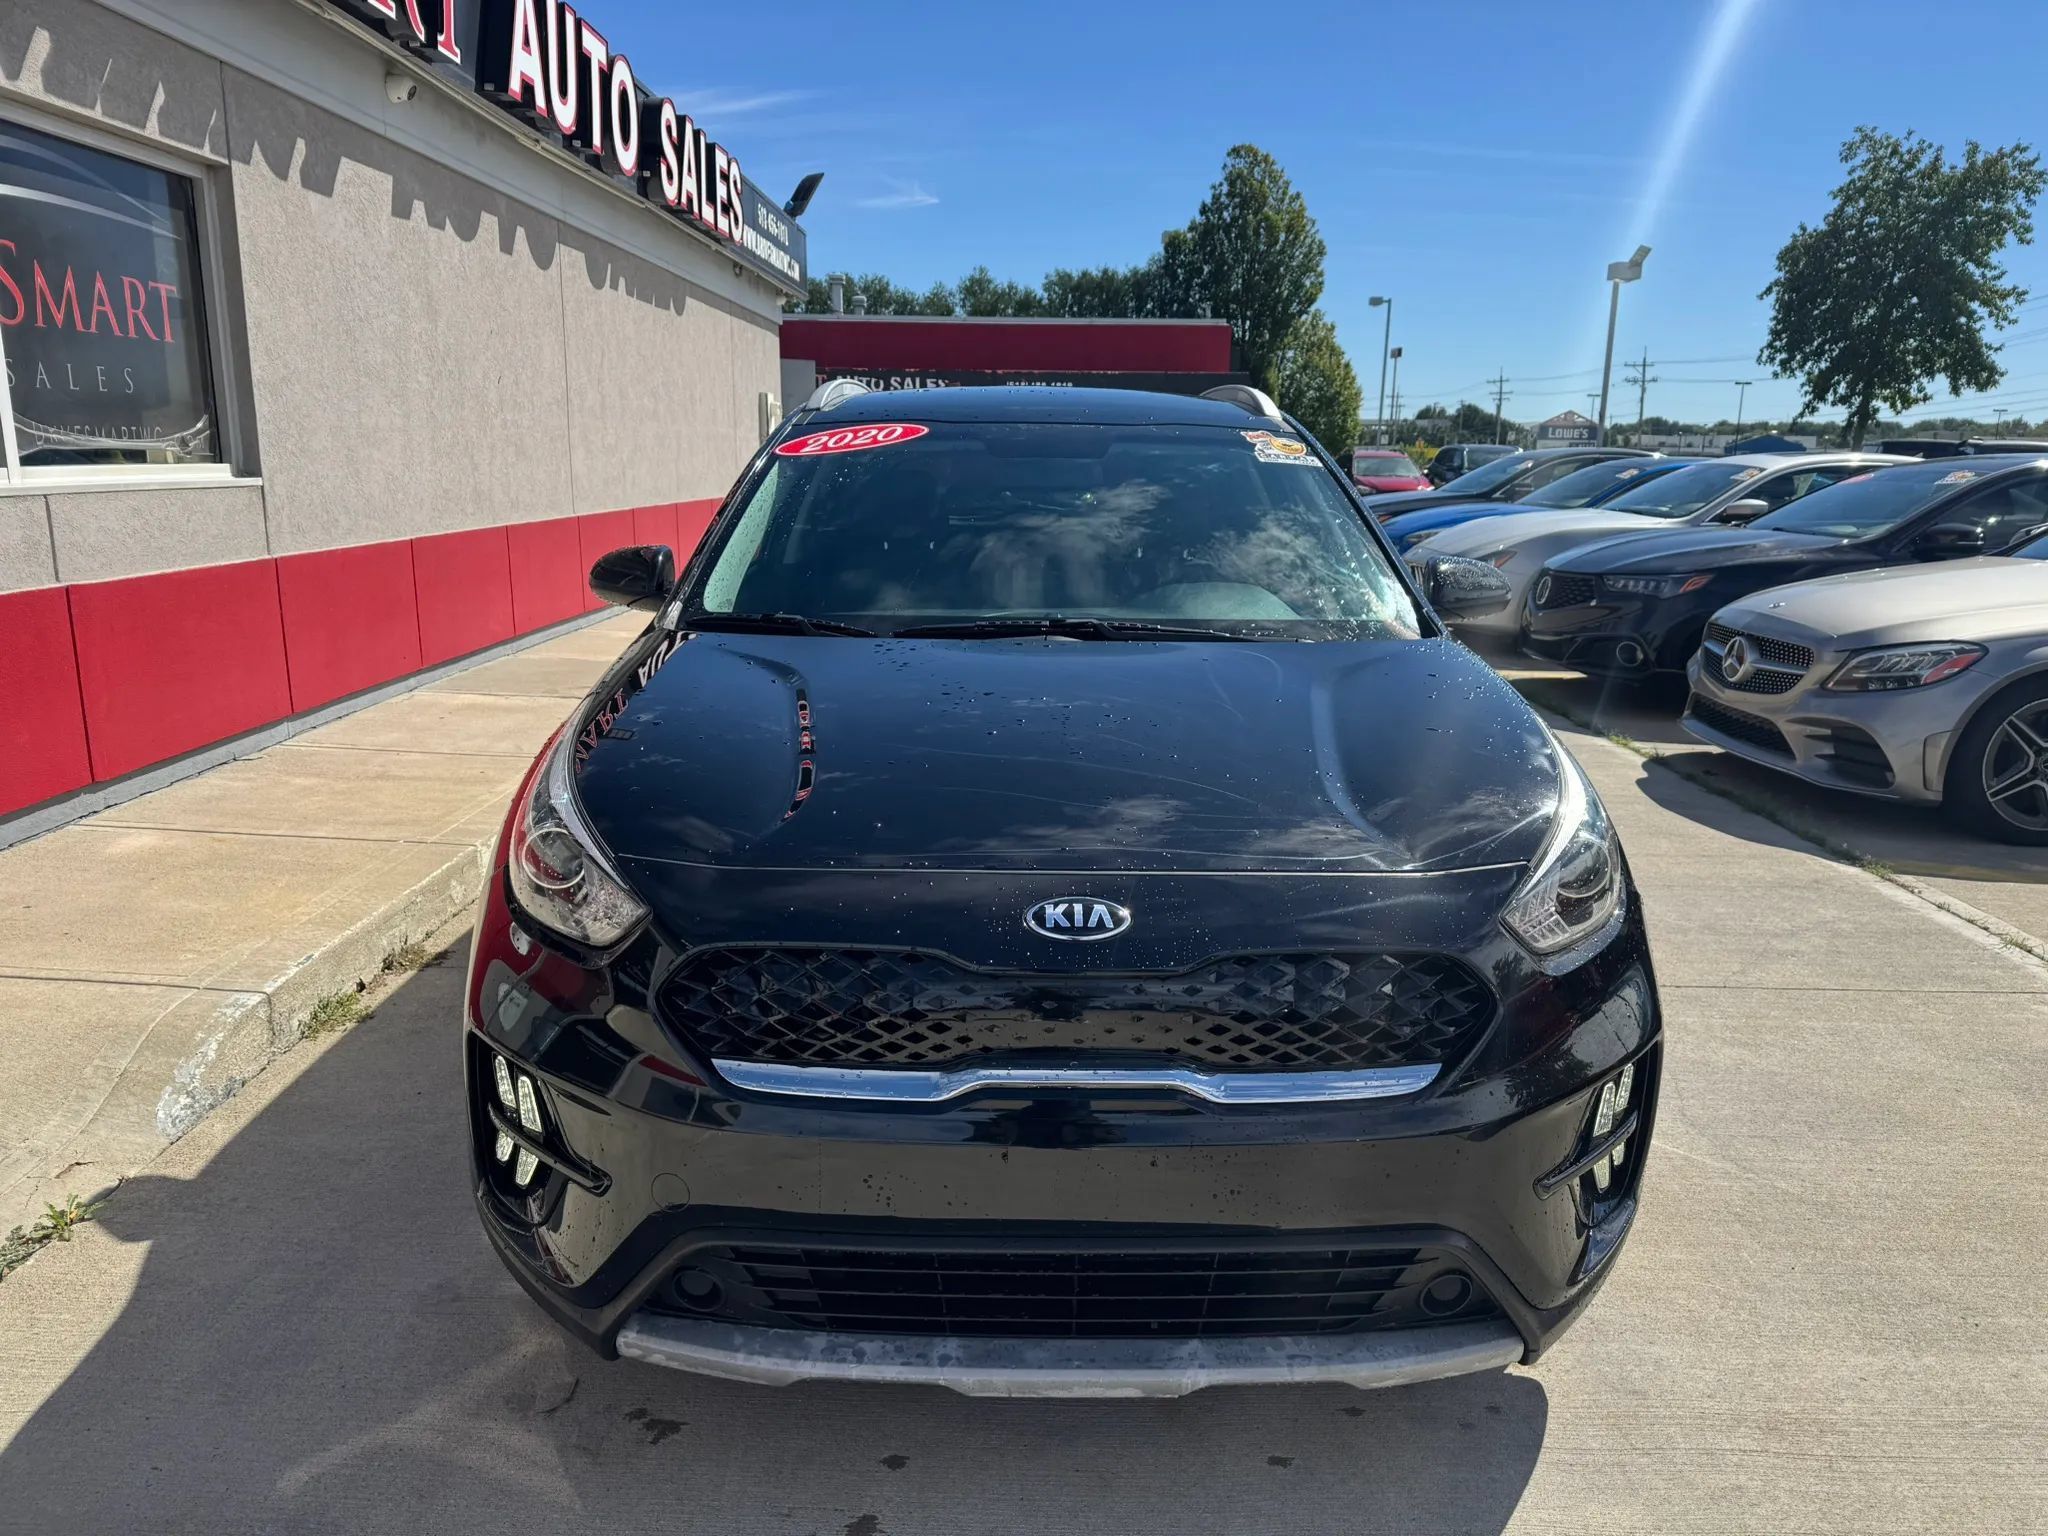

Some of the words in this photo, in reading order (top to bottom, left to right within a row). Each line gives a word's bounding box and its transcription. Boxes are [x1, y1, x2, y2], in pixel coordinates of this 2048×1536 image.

[508, 0, 640, 177] AUTO
[660, 97, 743, 246] SALES
[0, 239, 178, 344] SMART
[3, 358, 134, 394] SALES
[799, 425, 904, 453] 2020
[1548, 427, 1589, 438] LOWE'S
[1043, 903, 1115, 929] KIA
